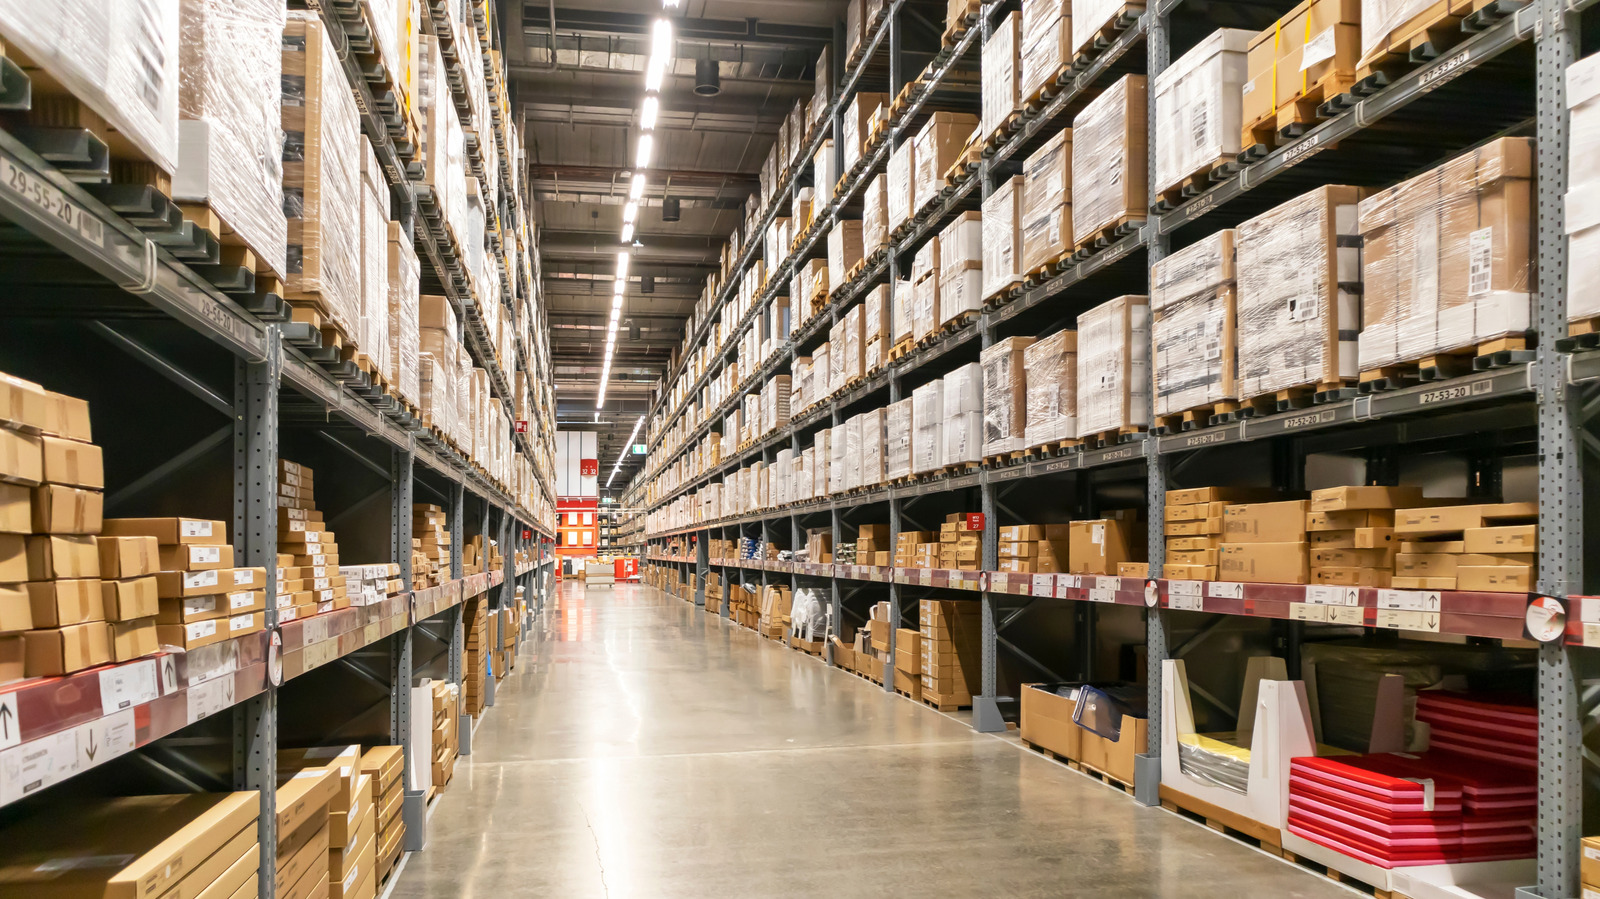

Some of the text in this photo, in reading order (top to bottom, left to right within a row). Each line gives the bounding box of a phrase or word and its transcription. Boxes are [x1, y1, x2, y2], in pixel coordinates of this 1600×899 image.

[1424, 53, 1465, 82] 27-53-30
[1286, 137, 1315, 160] 27-52-30
[9, 165, 72, 225] 29-55-20
[201, 298, 232, 331] 29-54-20
[1424, 387, 1466, 403] 27-53-20
[1287, 415, 1317, 428] 27-52-20
[1189, 435, 1212, 446] 27-51-20
